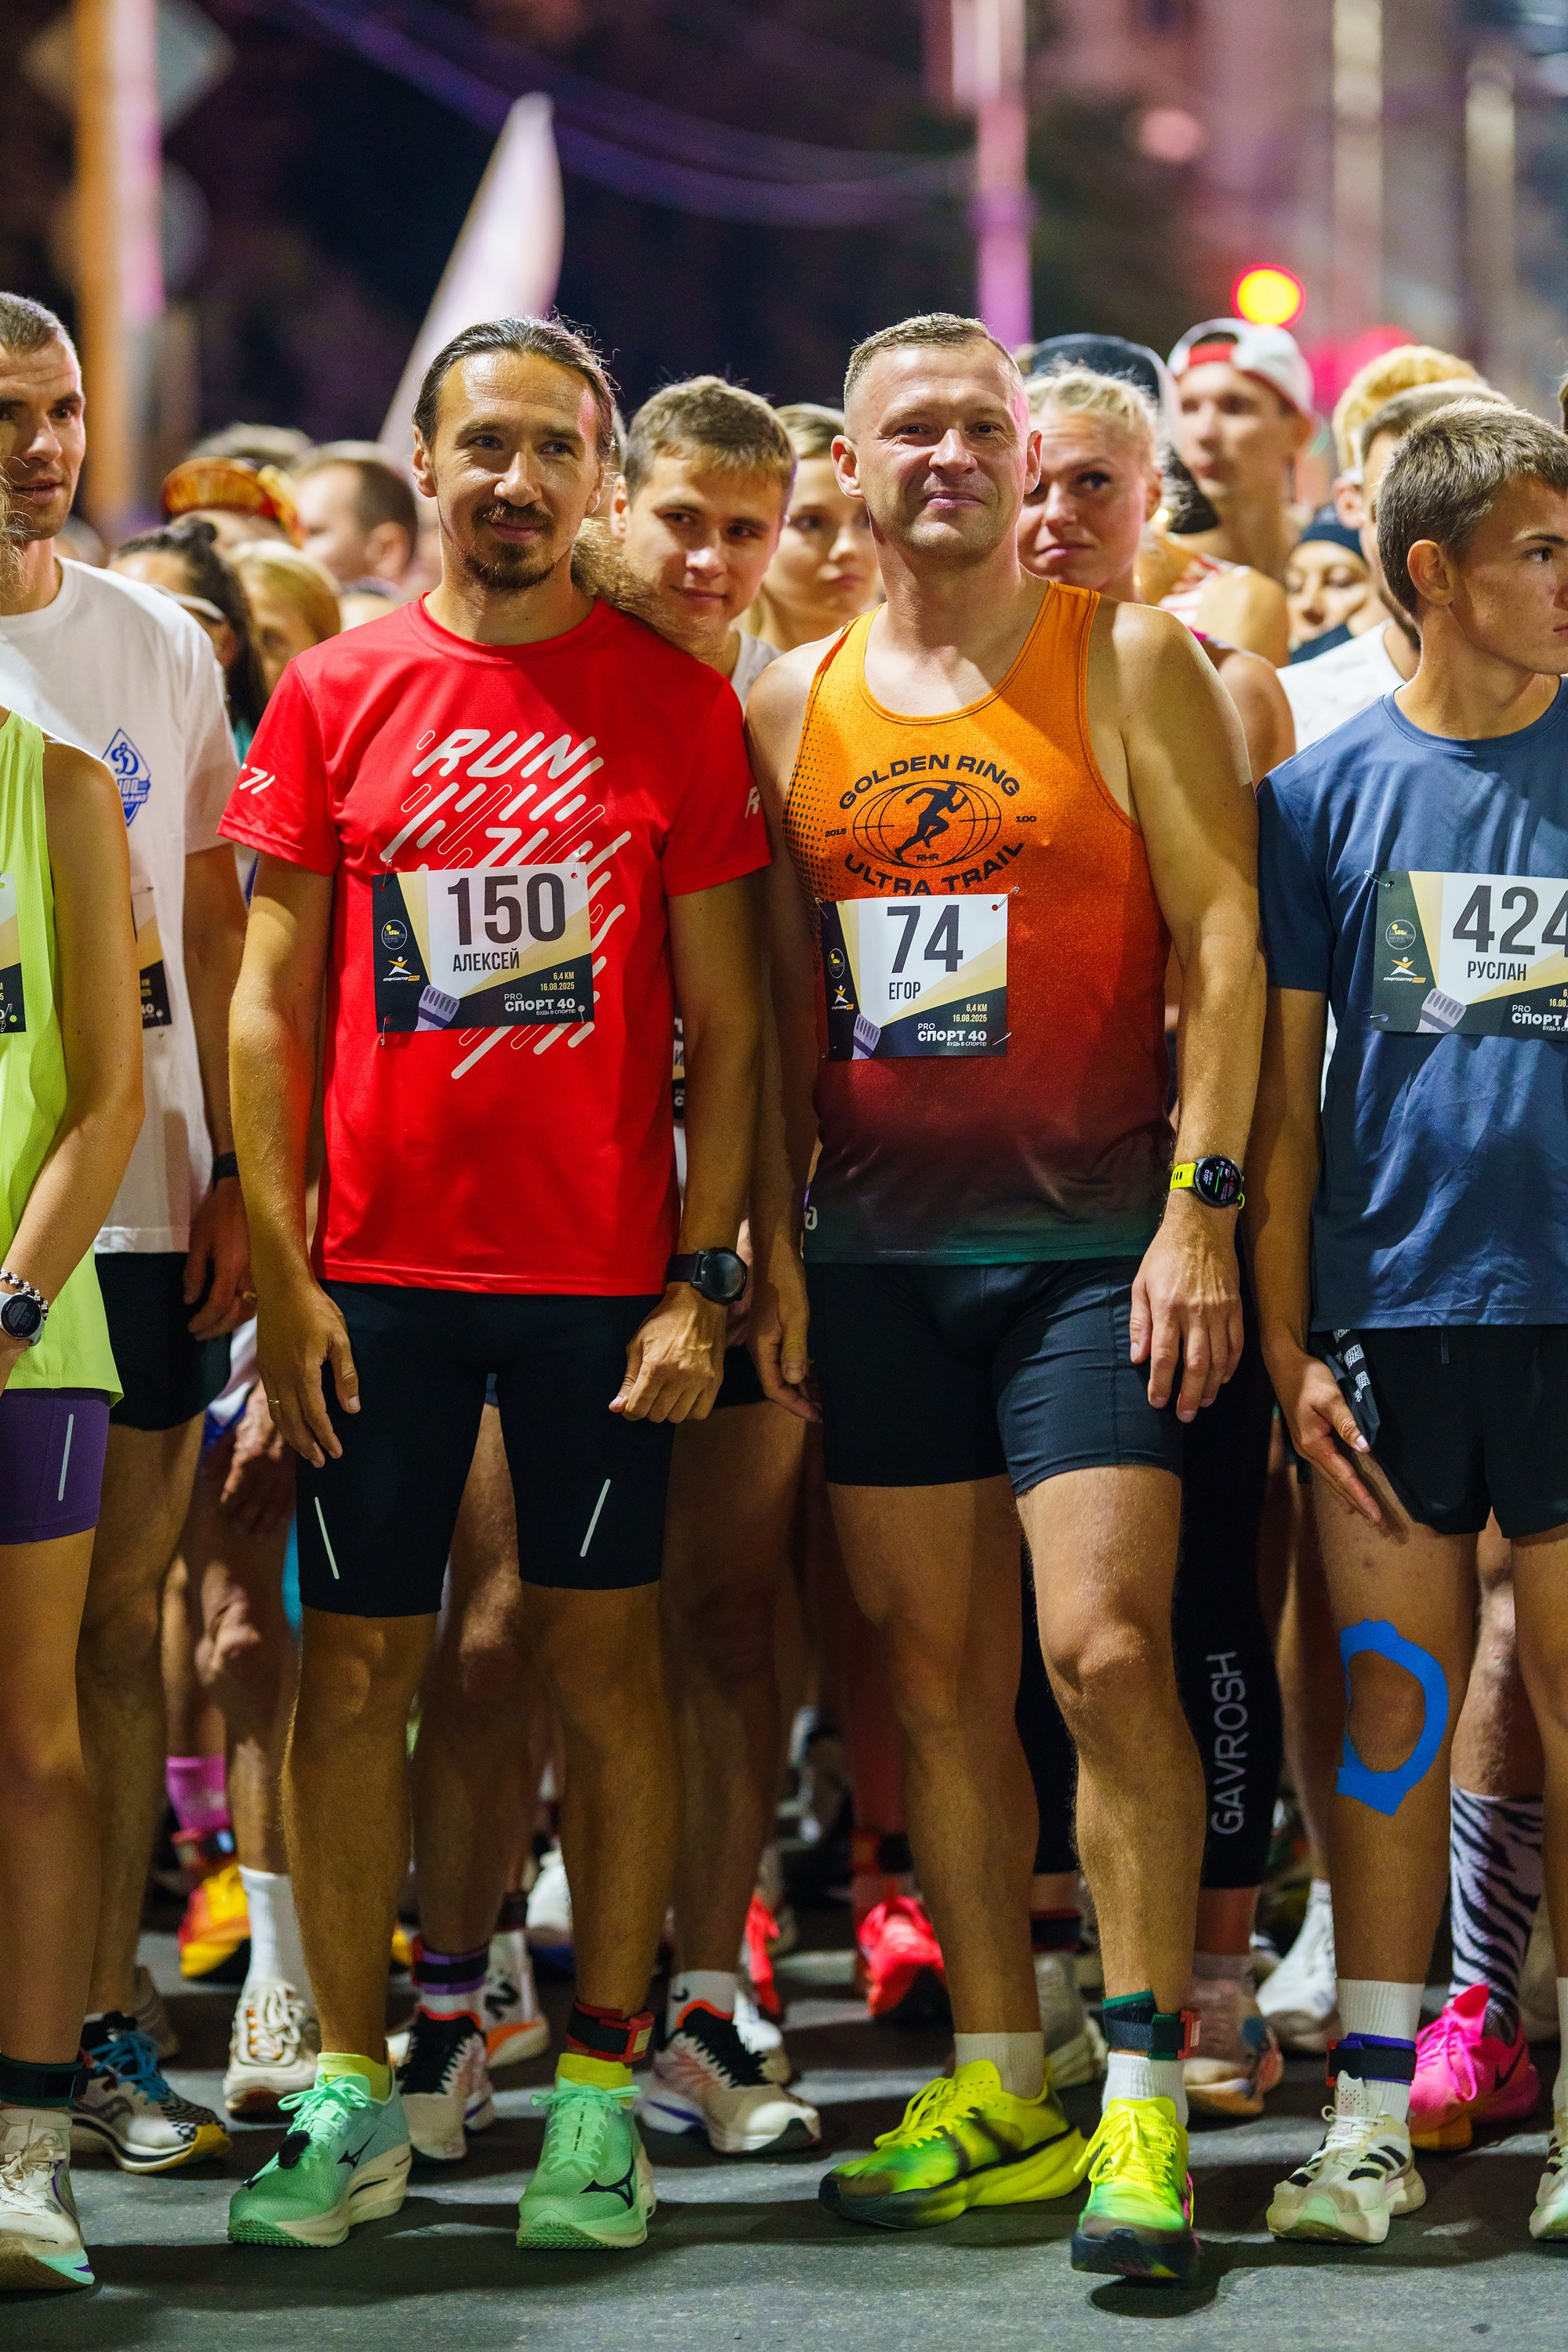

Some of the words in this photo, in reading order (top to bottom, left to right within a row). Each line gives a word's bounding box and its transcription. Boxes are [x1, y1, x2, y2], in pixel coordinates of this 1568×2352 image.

[412, 728, 597, 779] RUN
[839, 754, 949, 810] GOLDEN
[956, 755, 1020, 797] RING
[916, 853, 940, 862] RHR
[844, 853, 932, 896] ULTRA
[941, 842, 1025, 893] TRAIL
[448, 873, 566, 946] 150
[1453, 885, 1568, 958] 424
[887, 905, 964, 974] 74
[452, 947, 520, 972] АЛЕКСЕЙ
[553, 971, 564, 981] 6,4
[1467, 960, 1527, 981] РУСЛАН
[540, 982, 575, 991] 16.08.2025
[888, 982, 921, 1000] ЕГОР
[505, 999, 554, 1012] СПОРТ
[557, 998, 575, 1009] 40
[966, 1004, 976, 1013] 6,4
[1512, 1004, 1531, 1013] PRO
[953, 1014, 987, 1022] 16.08.2025
[1512, 1012, 1563, 1026] СПОРТ
[917, 1030, 966, 1042] СПОРТ
[967, 1030, 987, 1042] 40
[1206, 1650, 1250, 1835] GAVROSH
